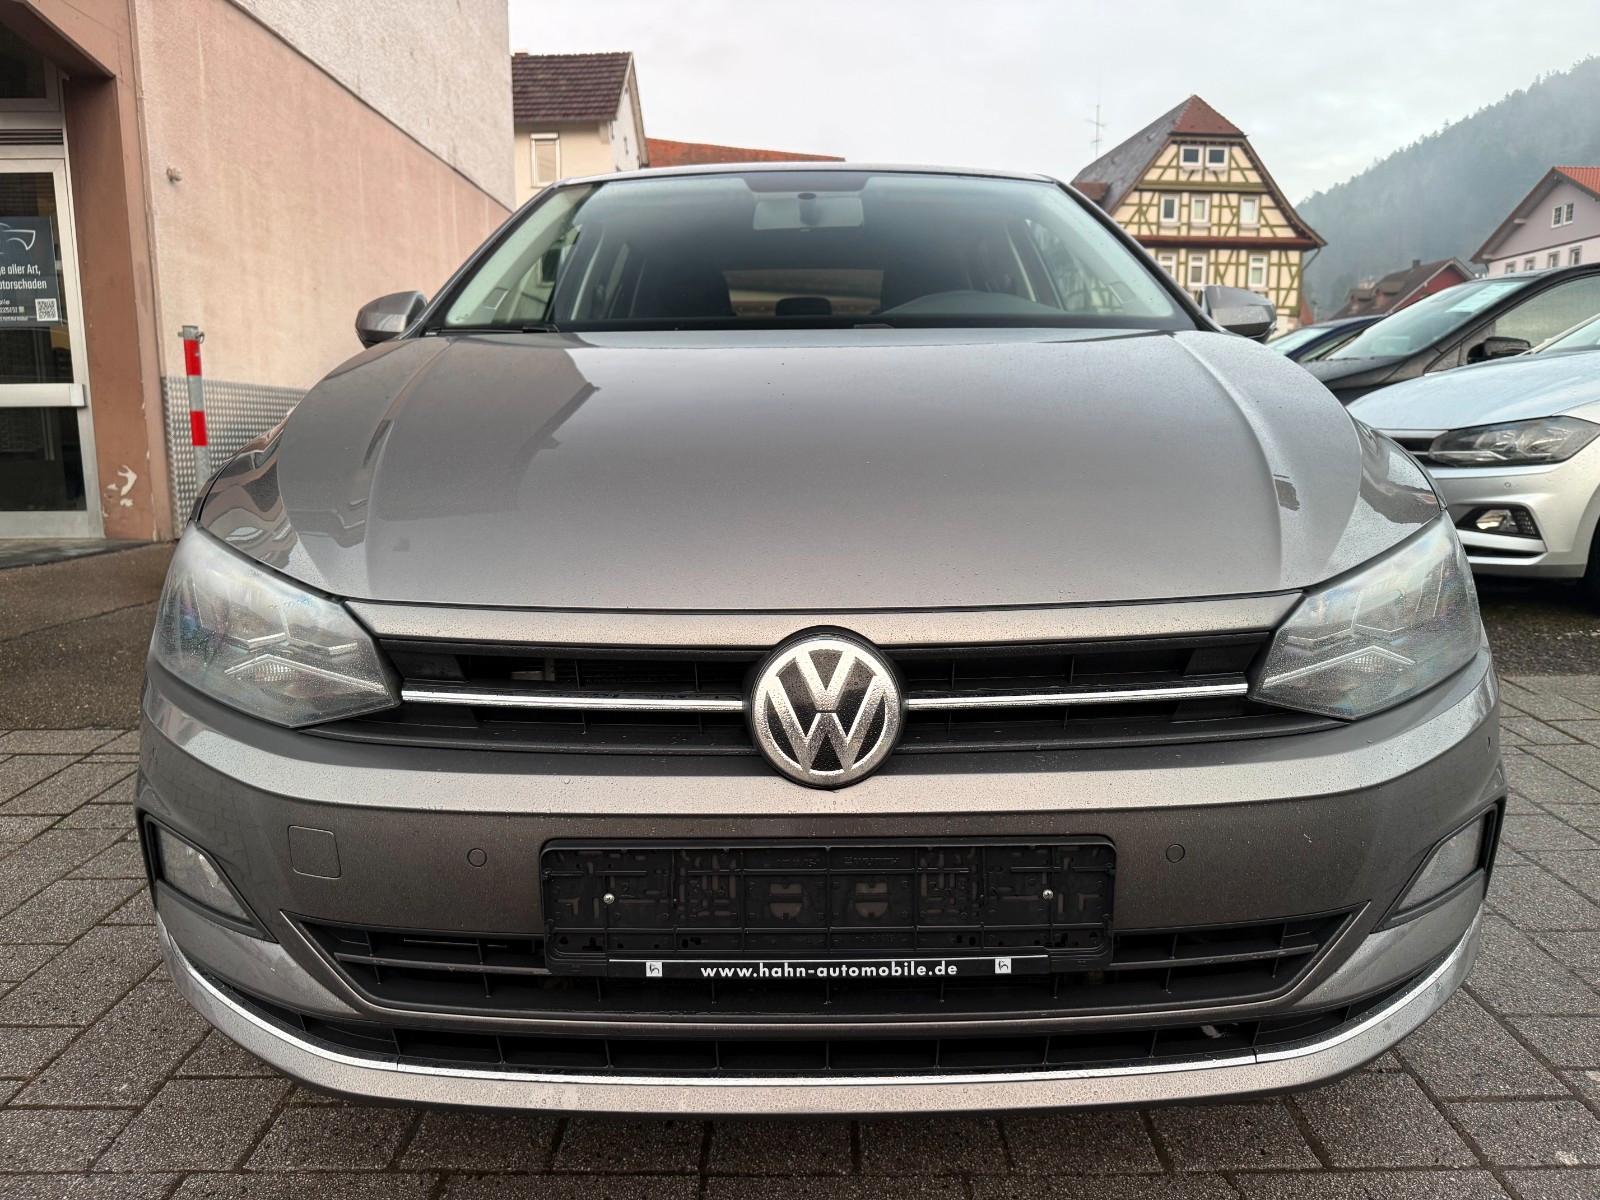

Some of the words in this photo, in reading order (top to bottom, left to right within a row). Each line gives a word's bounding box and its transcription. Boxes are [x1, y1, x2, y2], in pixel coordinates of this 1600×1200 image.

[7, 263, 25, 275] aller
[27, 263, 41, 276] Art,
[757, 641, 894, 783] VW
[700, 960, 958, 978] www.hahn-automobile.de
